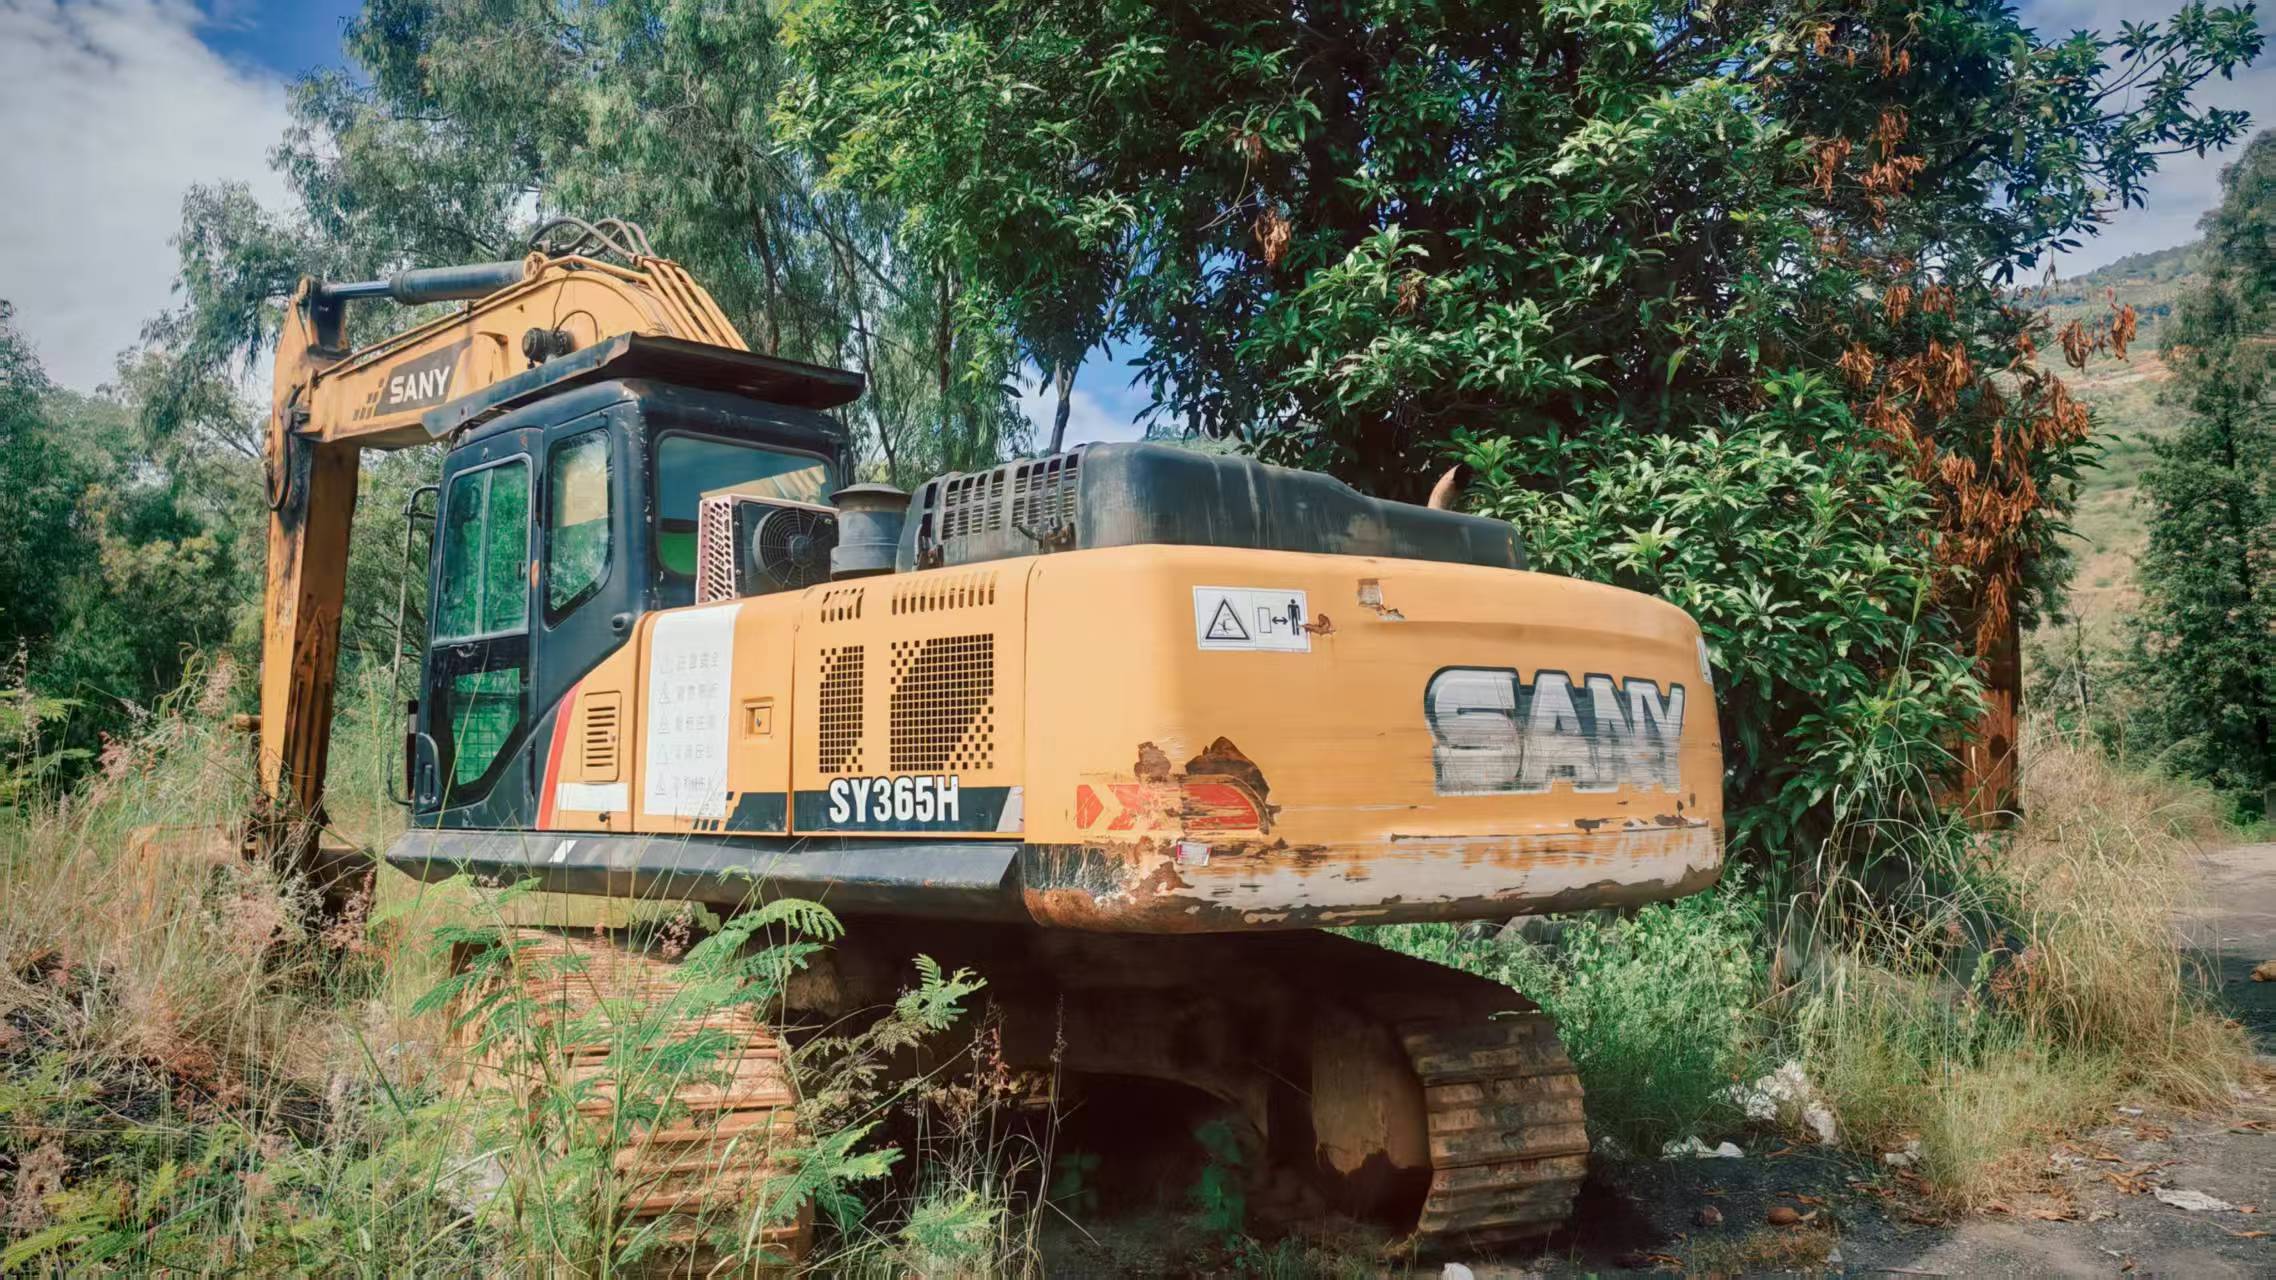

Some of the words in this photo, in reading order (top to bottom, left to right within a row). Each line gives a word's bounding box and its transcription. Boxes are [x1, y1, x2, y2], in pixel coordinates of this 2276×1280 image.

[389, 365, 451, 404] SANY
[1424, 665, 1686, 796] SANY
[828, 775, 960, 823] SY365H
